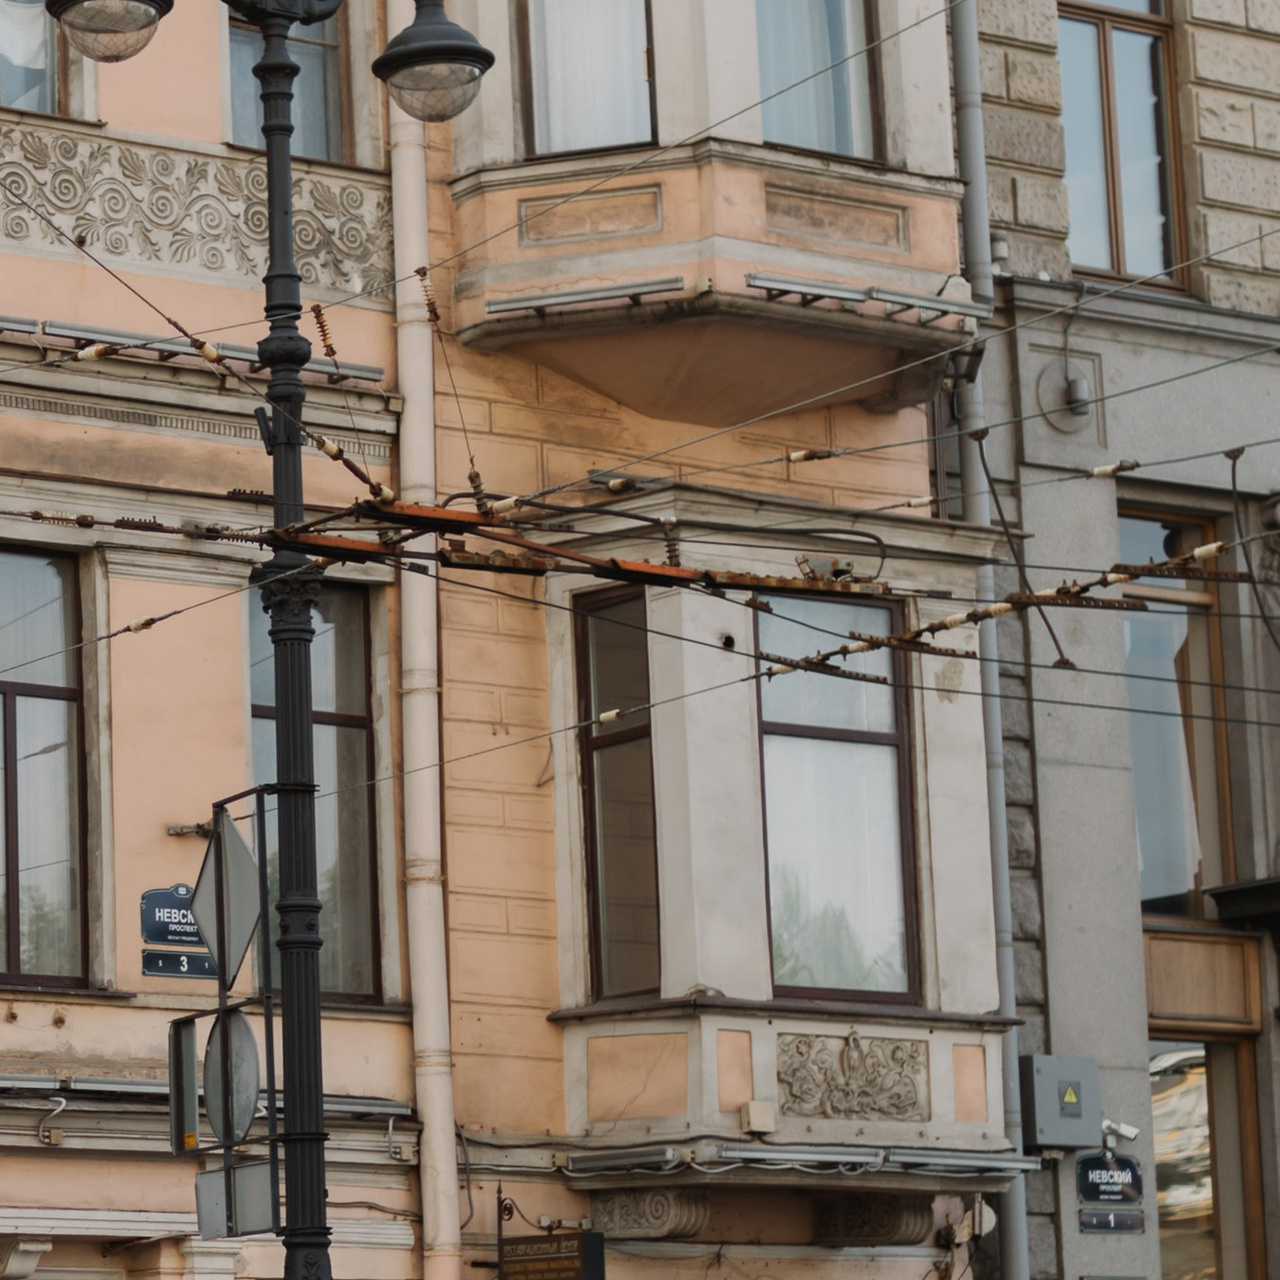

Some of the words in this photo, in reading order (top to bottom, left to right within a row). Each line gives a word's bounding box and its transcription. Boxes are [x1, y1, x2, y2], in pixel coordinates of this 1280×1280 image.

[169, 924, 198, 932] ПРОСПЕКТ
[180, 956, 188, 972] 3
[1088, 1168, 1132, 1184] НЕВСКИЙ
[1108, 1212, 1115, 1228] 1
